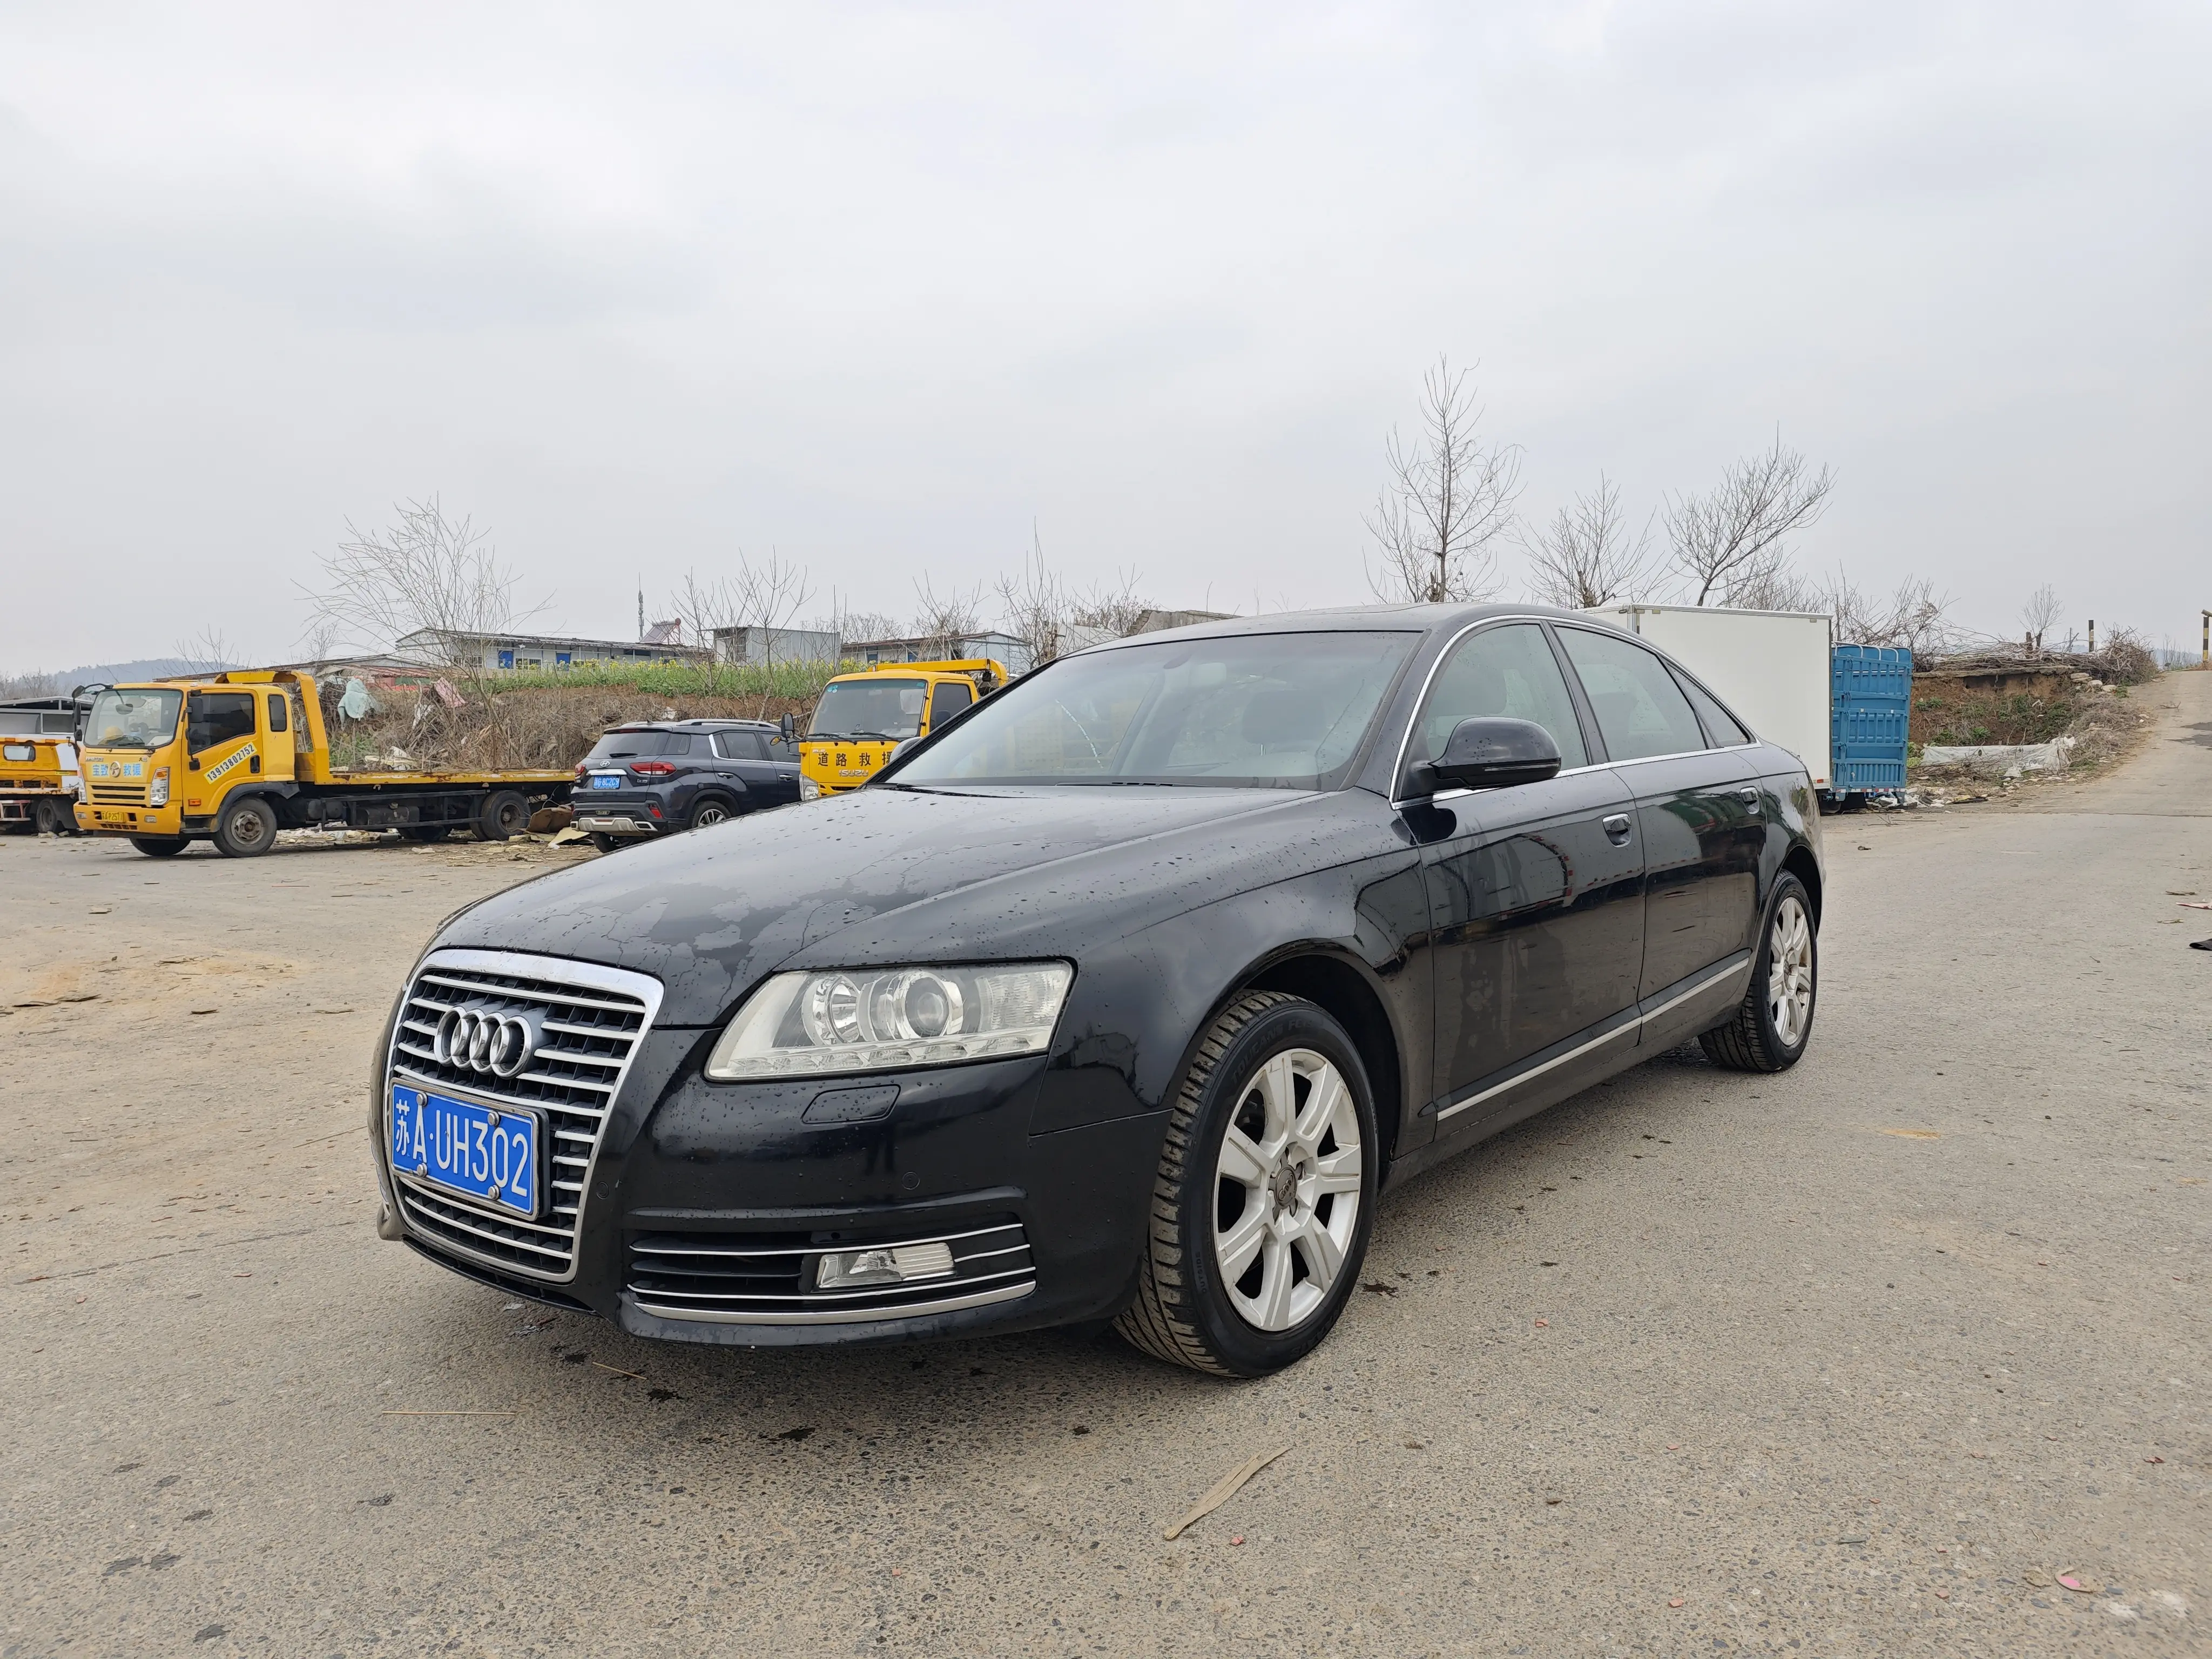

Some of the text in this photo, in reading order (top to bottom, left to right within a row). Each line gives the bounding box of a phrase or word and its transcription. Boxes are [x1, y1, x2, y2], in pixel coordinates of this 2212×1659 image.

[207, 744, 255, 781] 13913802752
[818, 751, 893, 766] 道路救援
[396, 1098, 528, 1197] 苏A·UH302
[1195, 1251, 1207, 1294] OUTSIDE
